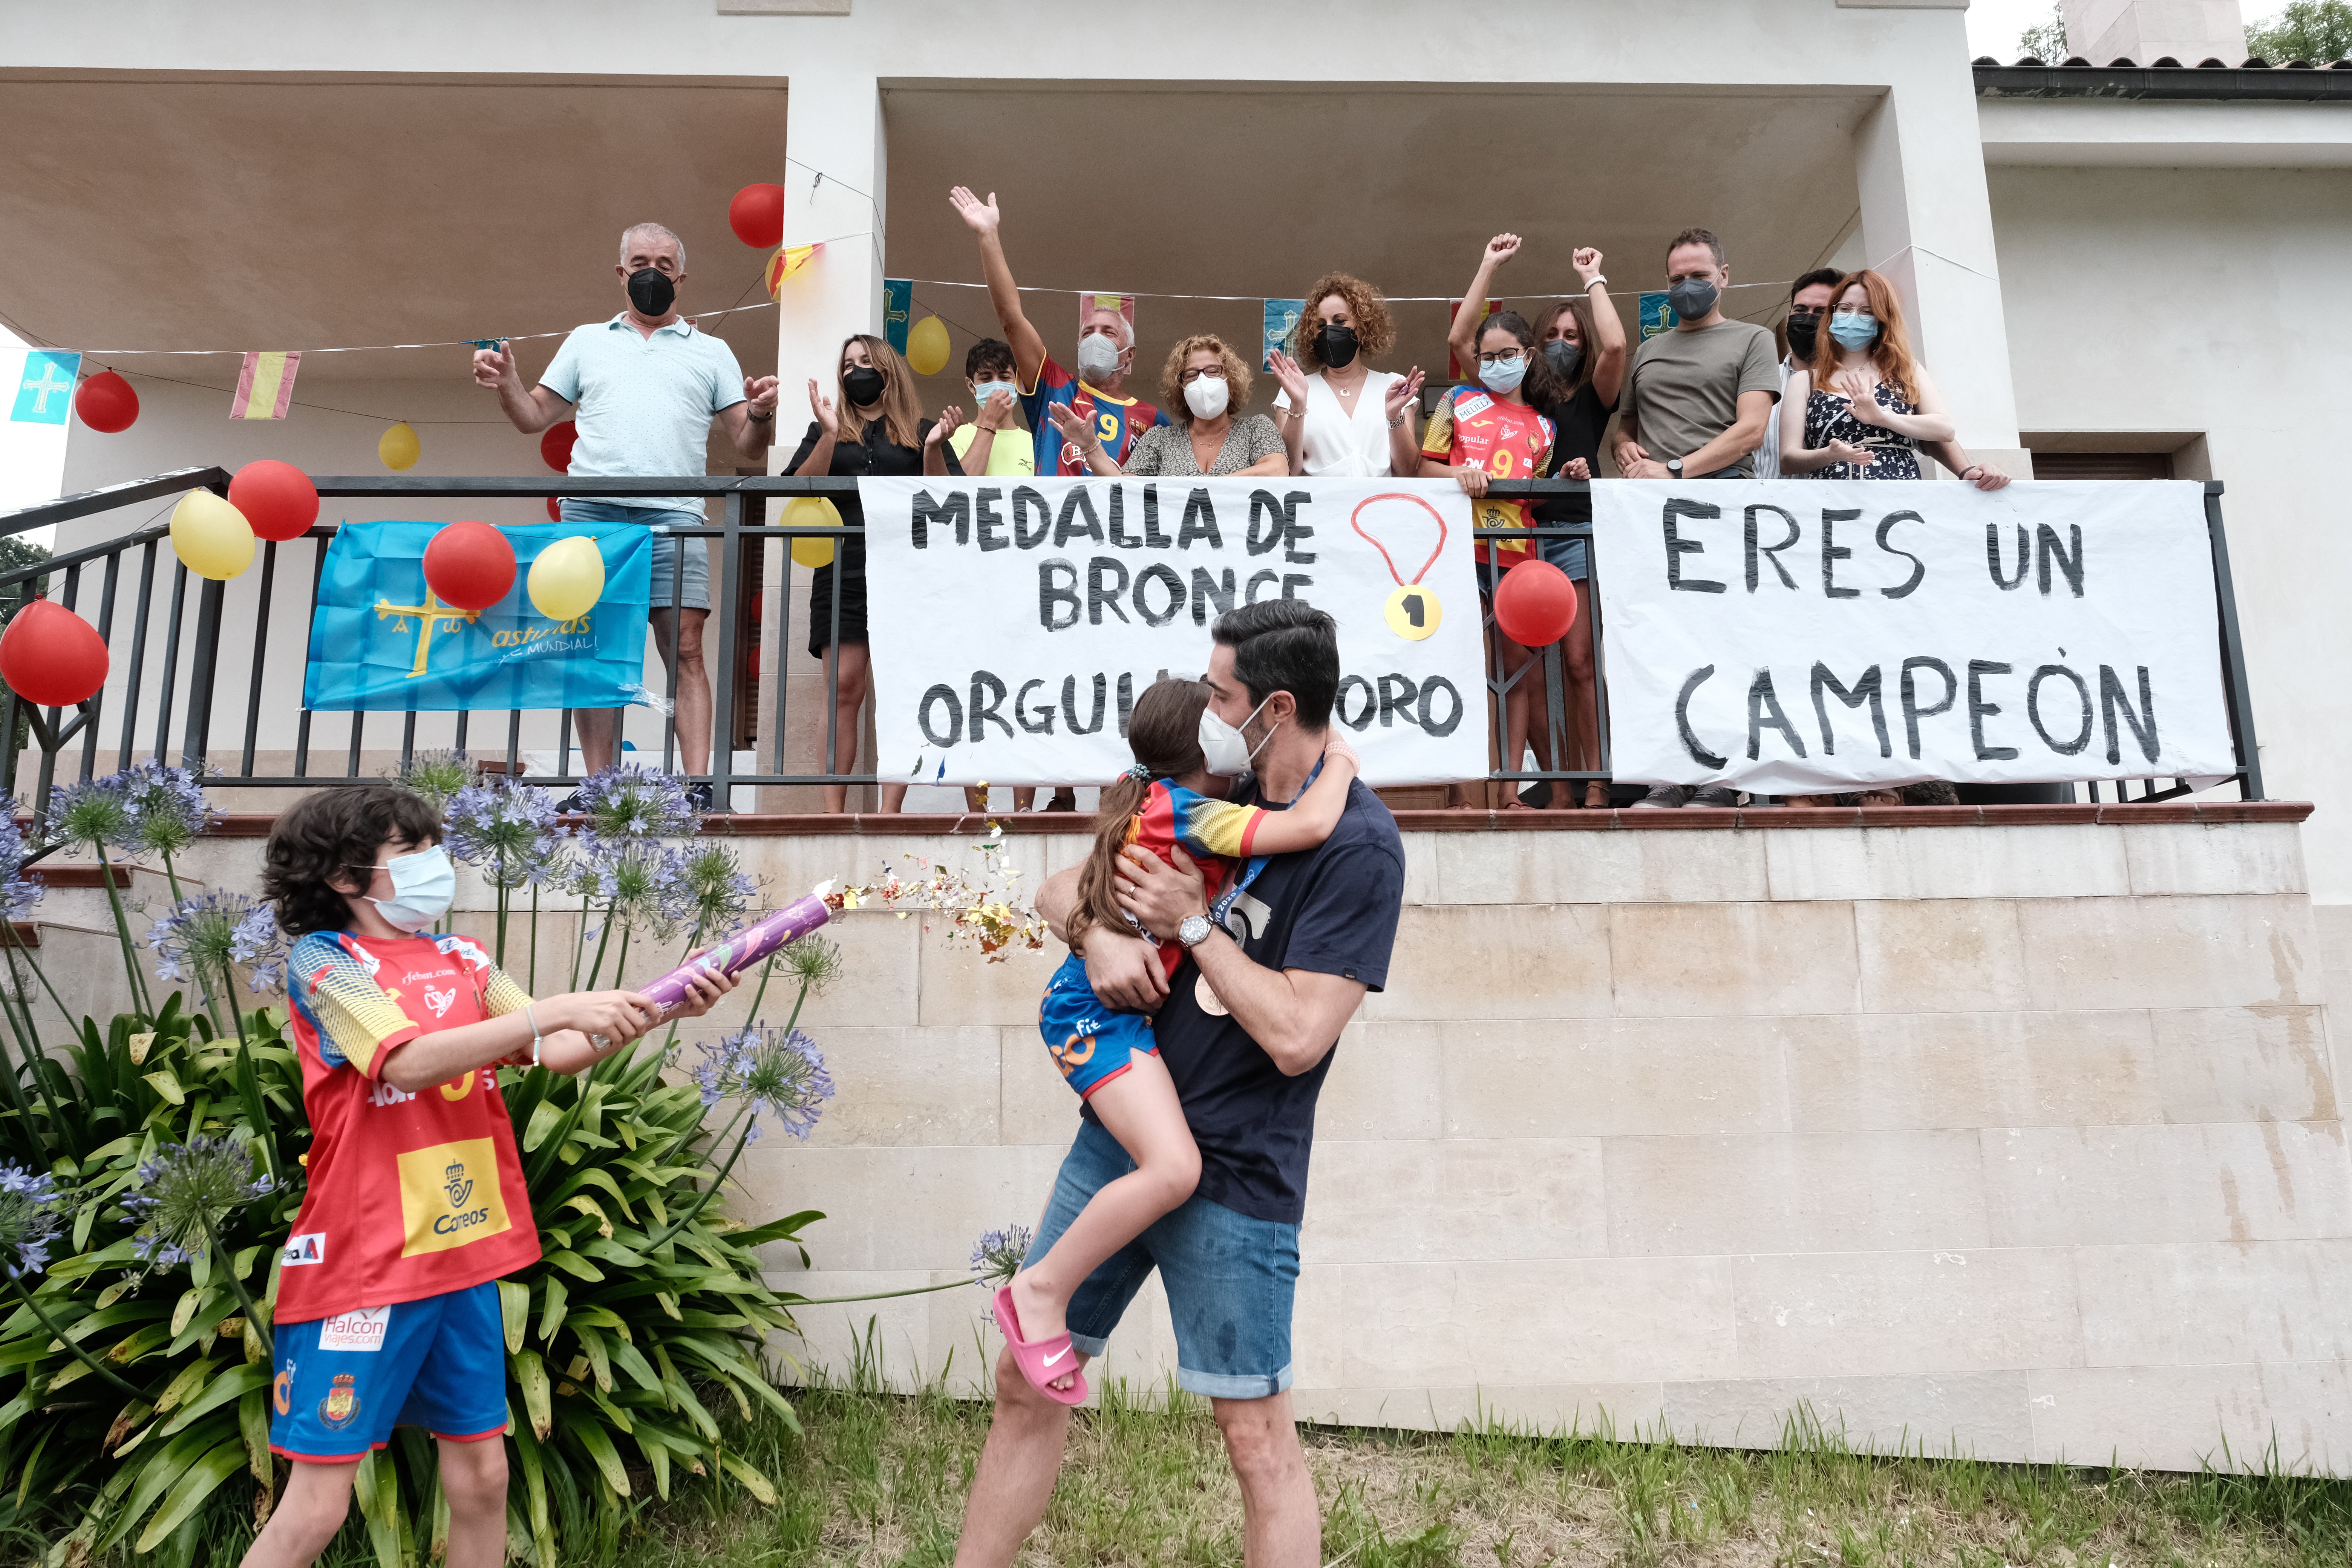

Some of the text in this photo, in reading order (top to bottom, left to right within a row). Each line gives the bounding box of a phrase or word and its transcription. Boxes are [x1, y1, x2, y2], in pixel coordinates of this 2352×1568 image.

[1097, 414, 1118, 441] 9
[1458, 434, 1489, 444] Popular
[1490, 449, 1513, 479] 9
[911, 484, 1319, 564] MEDALLA DE
[1663, 498, 2085, 599] ERES UN
[1401, 594, 1424, 627] 1
[528, 635, 599, 654] MUNDIAL!
[919, 670, 1464, 749] ORGUL ORO
[1217, 892, 1236, 911] 2020
[402, 969, 456, 985] rfebm.com
[1076, 1018, 1101, 1037] fit
[325, 1333, 381, 1347] viajes.com
